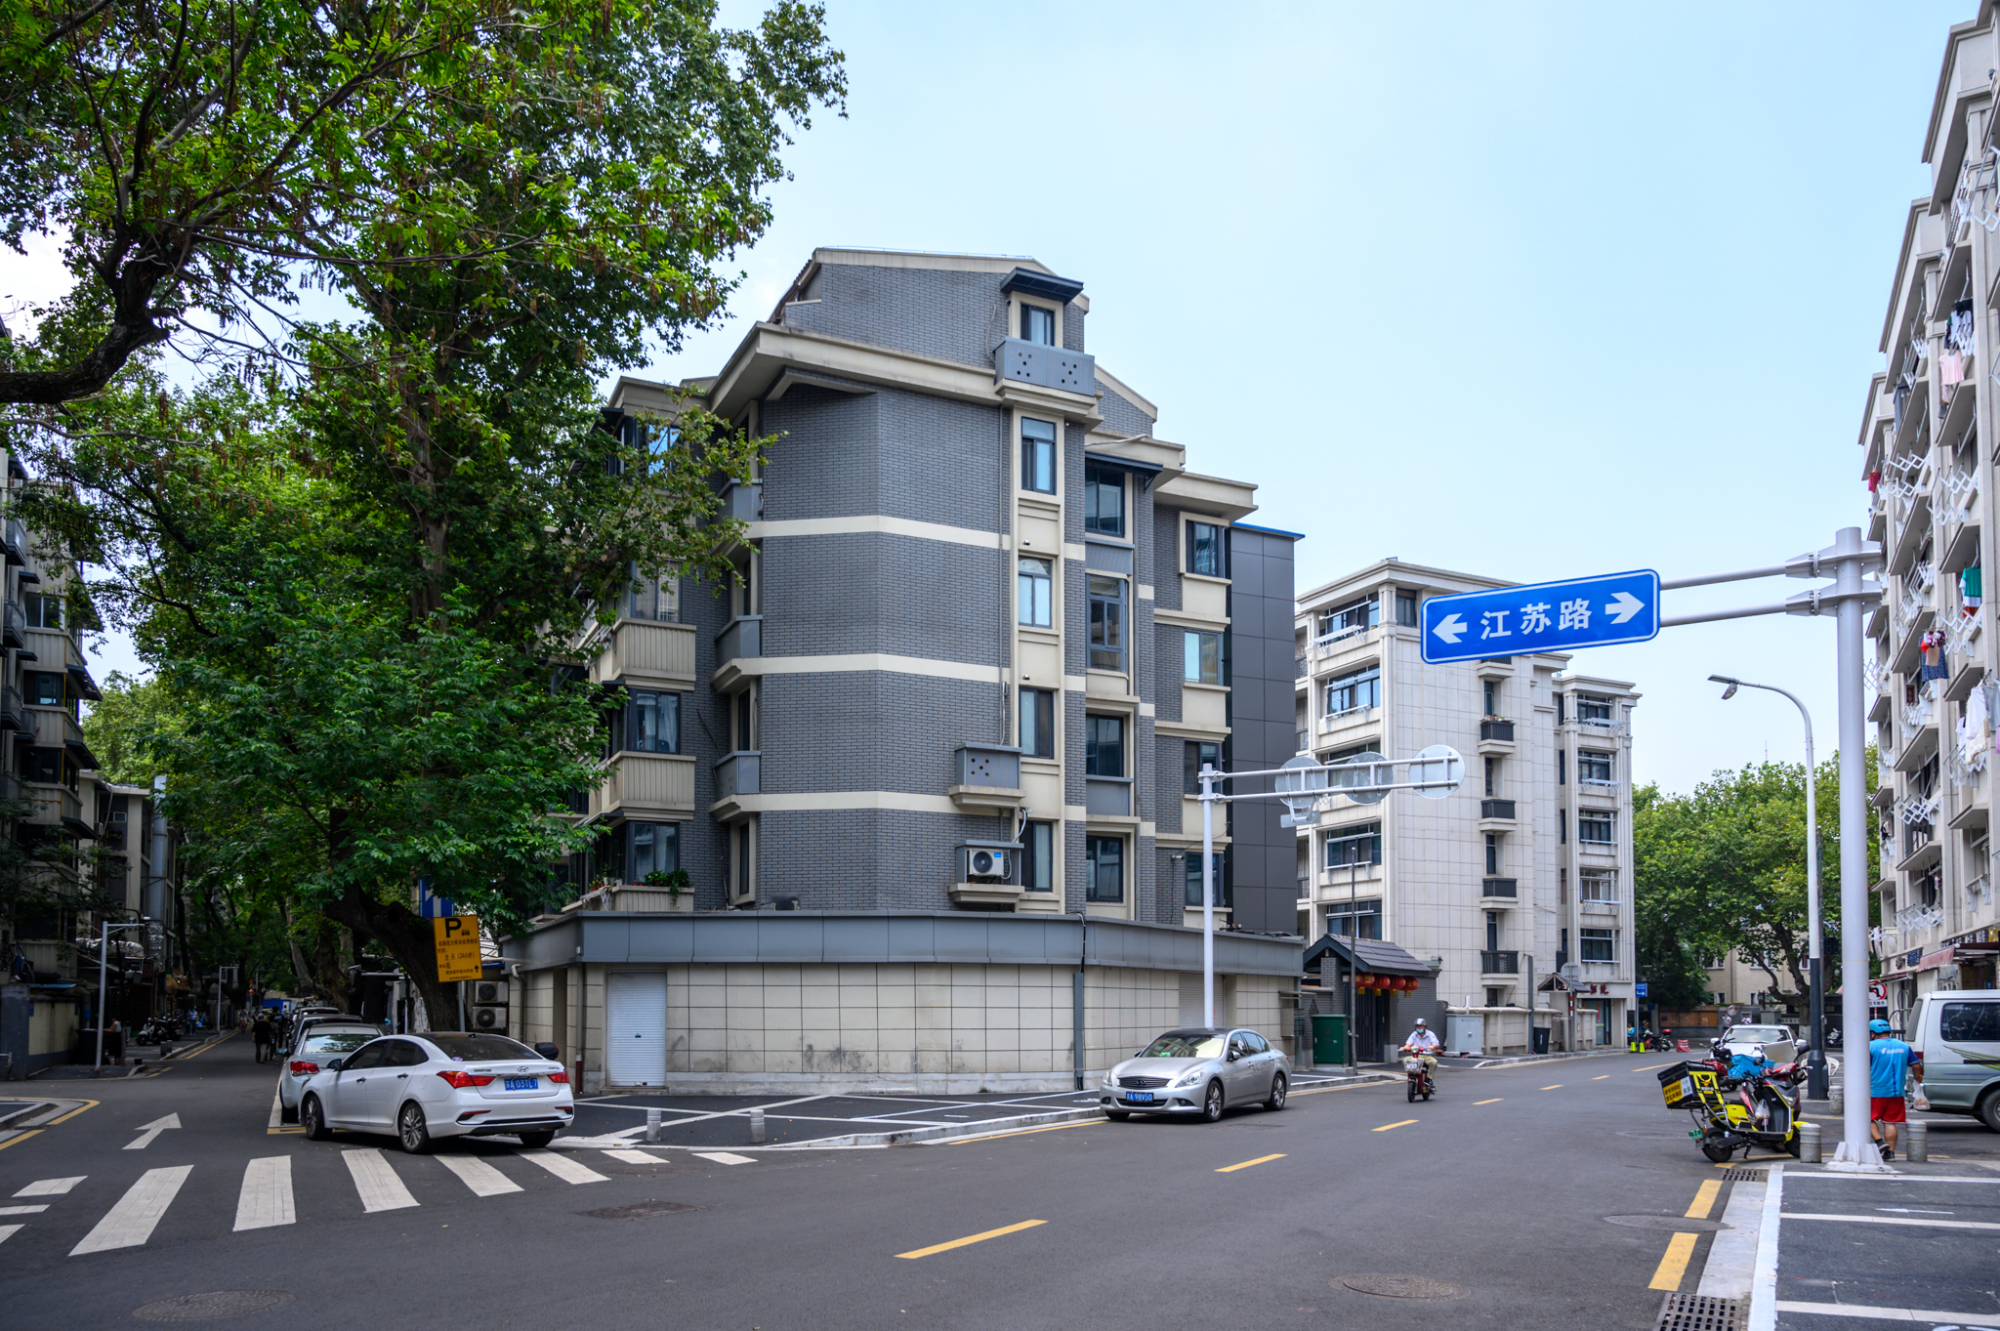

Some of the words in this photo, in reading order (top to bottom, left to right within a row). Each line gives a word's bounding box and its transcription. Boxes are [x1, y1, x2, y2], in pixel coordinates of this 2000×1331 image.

[1480, 598, 1592, 640] 江苏路
[445, 917, 462, 938] P
